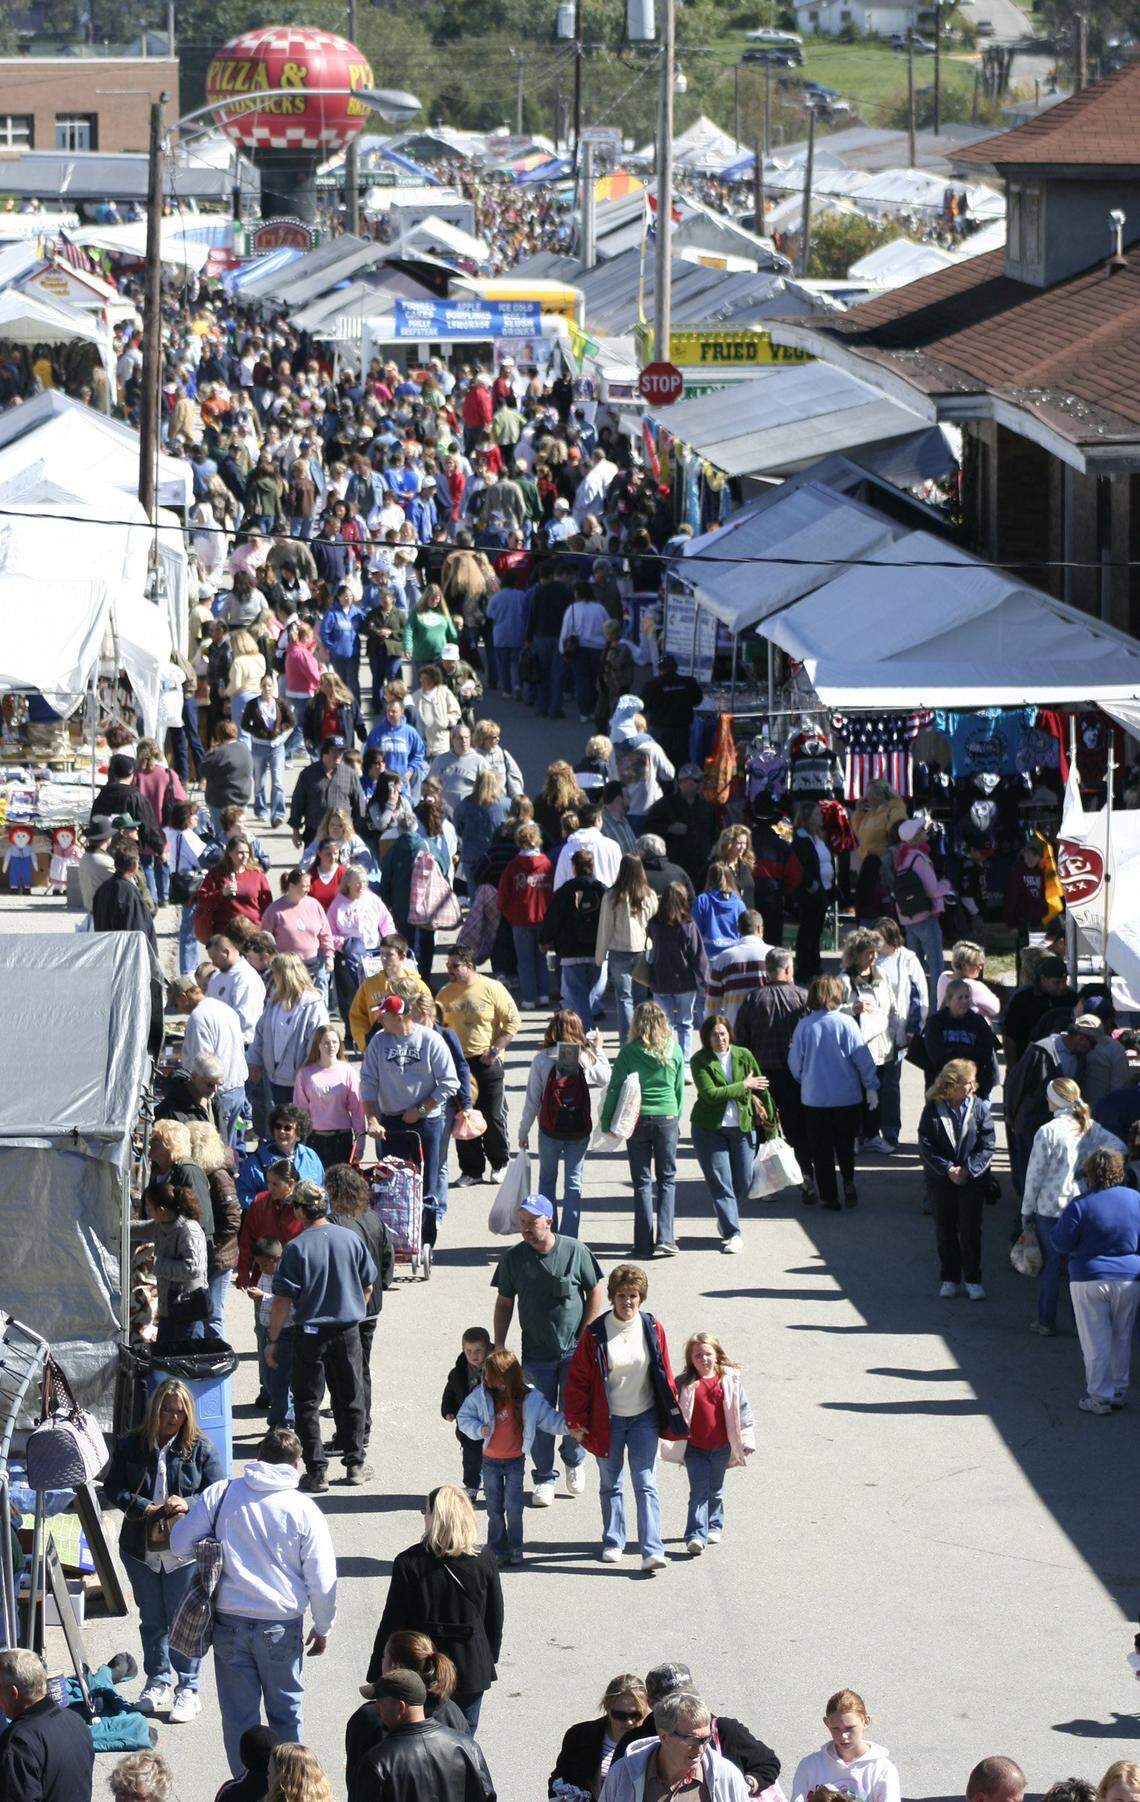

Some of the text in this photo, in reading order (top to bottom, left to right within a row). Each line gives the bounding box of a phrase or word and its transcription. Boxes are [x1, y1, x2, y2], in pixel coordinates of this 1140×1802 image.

[207, 60, 309, 91] PIZZA &
[261, 232, 306, 247] PIZZA
[457, 302, 482, 312] APPLE
[498, 303, 512, 312] ICE
[512, 303, 534, 312] COLD
[701, 342, 758, 361] FRIED
[641, 375, 681, 393] STOP
[387, 1048, 421, 1061] EAGLES
